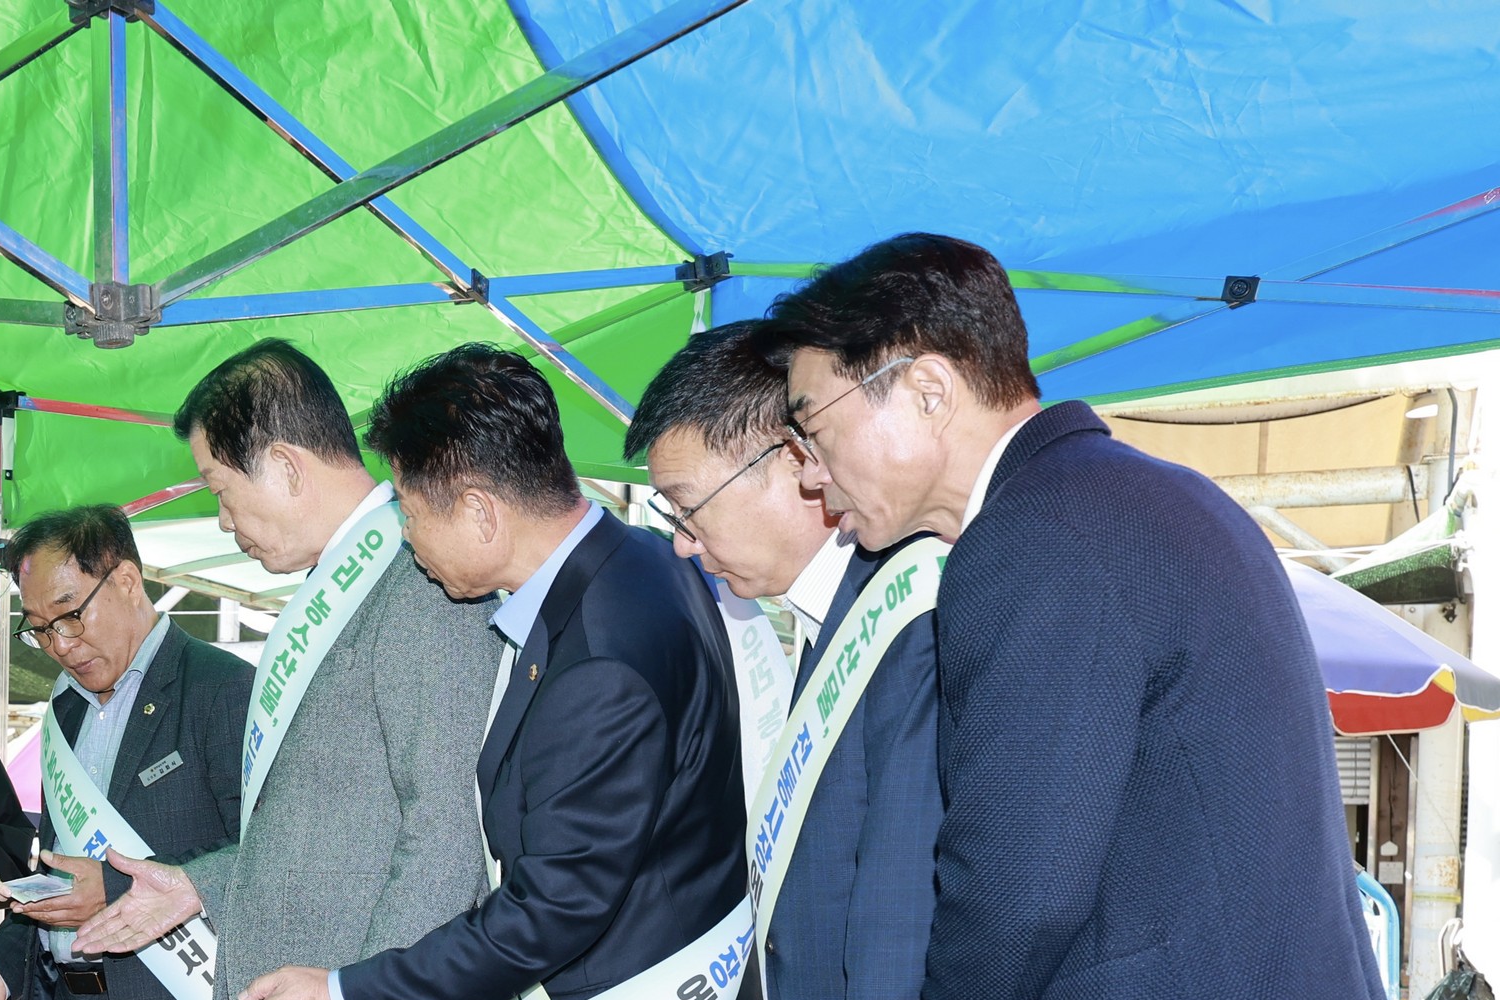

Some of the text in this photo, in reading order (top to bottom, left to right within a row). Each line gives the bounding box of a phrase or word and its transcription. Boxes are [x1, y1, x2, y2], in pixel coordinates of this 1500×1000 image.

[330, 528, 384, 593] 우리
[259, 589, 336, 728] 농수산물,
[818, 565, 919, 739] 농수산물,
